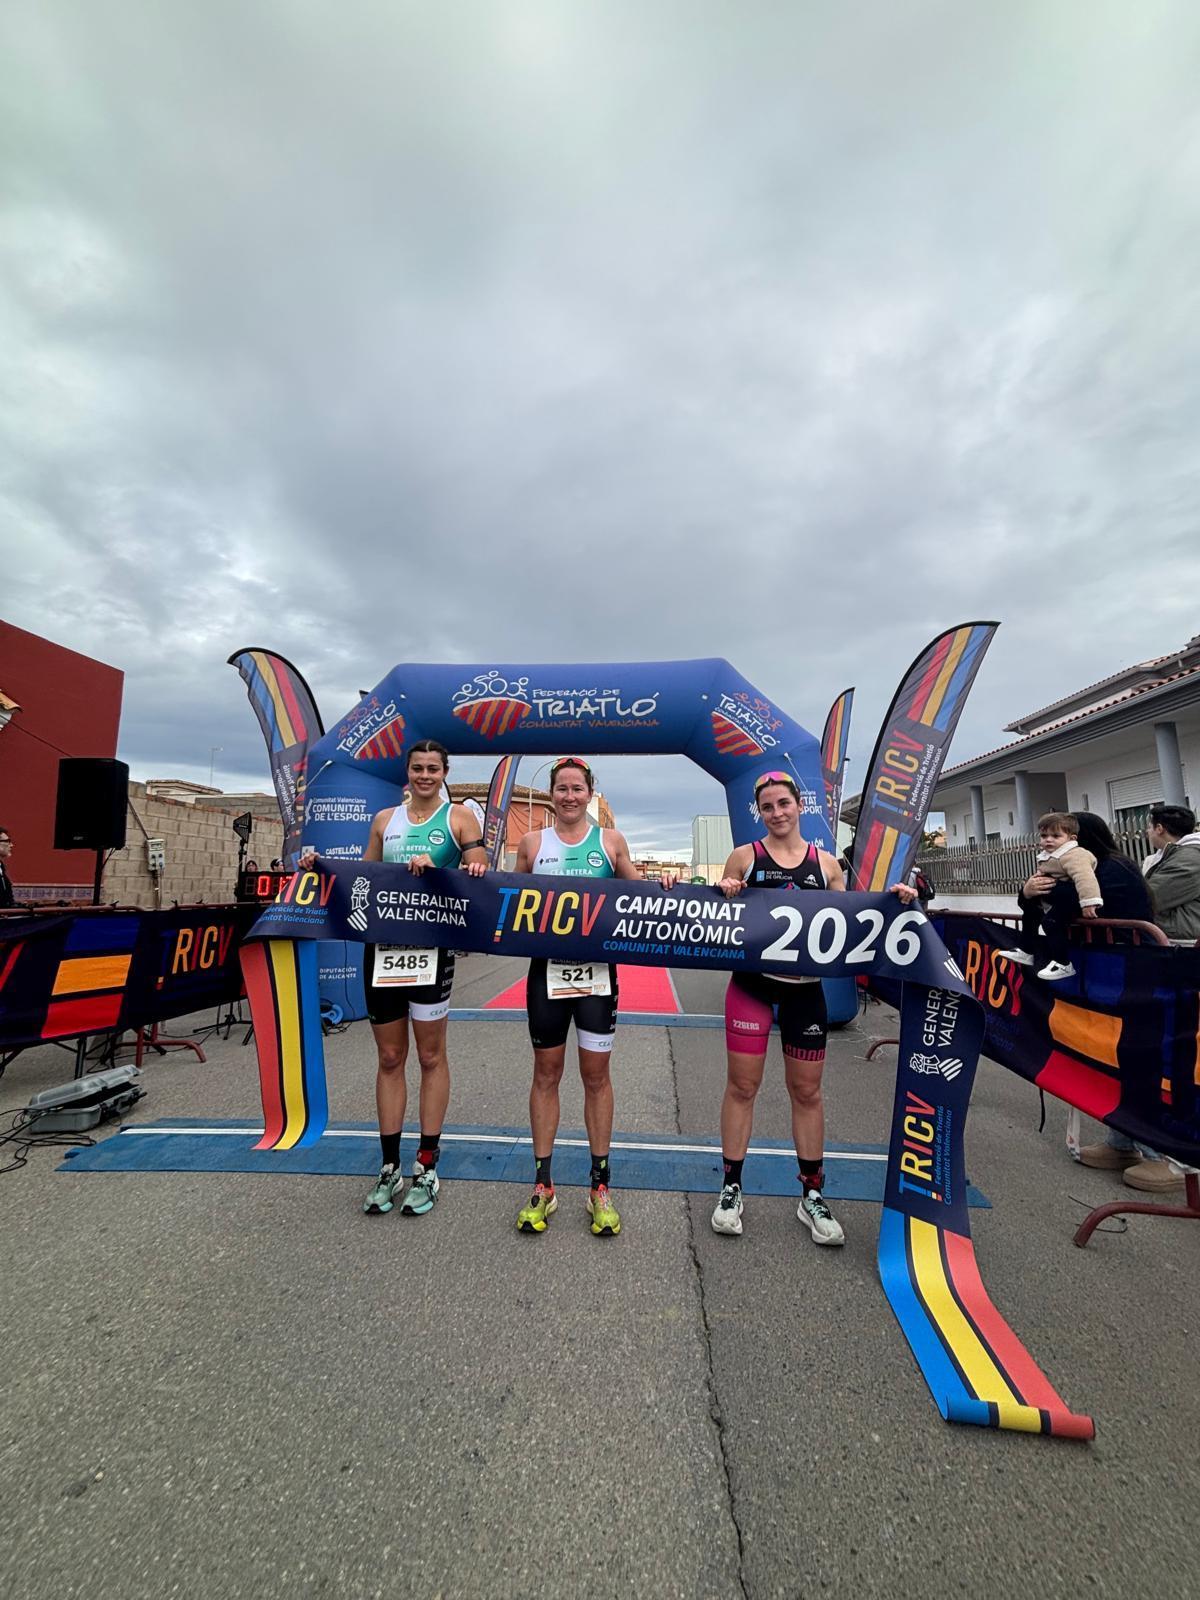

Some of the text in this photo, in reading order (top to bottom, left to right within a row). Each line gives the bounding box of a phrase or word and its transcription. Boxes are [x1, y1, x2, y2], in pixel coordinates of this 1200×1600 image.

[533, 688, 597, 697] FEDERACIÓ
[532, 692, 660, 718] TRIATLÓ
[336, 699, 397, 752] TRIATLÓ
[519, 720, 659, 729] COMUNITAT VALENCIANA
[720, 692, 781, 747] TRIATLÓ
[872, 729, 924, 817] TRICV
[909, 743, 935, 806] Federació de Triatló
[915, 747, 942, 821] Comunitat Valenciana
[312, 804, 367, 813] COMUNITAT
[315, 813, 373, 823] DE L'ESPORT
[325, 844, 362, 855] CASTELLÓN
[305, 907, 329, 916] Triatló
[376, 890, 470, 912] GENERALITAT
[614, 894, 746, 922] CAMPIONAT
[283, 914, 326, 925] Valenciana
[376, 906, 468, 928] VALENCIANA
[493, 887, 607, 942] TRICV
[612, 917, 745, 946] AUTONÒMIC
[760, 905, 928, 967] 2026
[602, 940, 746, 960] COMUNITAT VALENCIANA
[319, 966, 357, 974] DIPUTACIÓN
[382, 954, 429, 971] 5485
[561, 966, 593, 982] 521
[899, 1090, 943, 1202] TRICV
[934, 1104, 945, 1186] Federació de Triatló
[943, 1109, 953, 1206] Comunitat Valenciana
